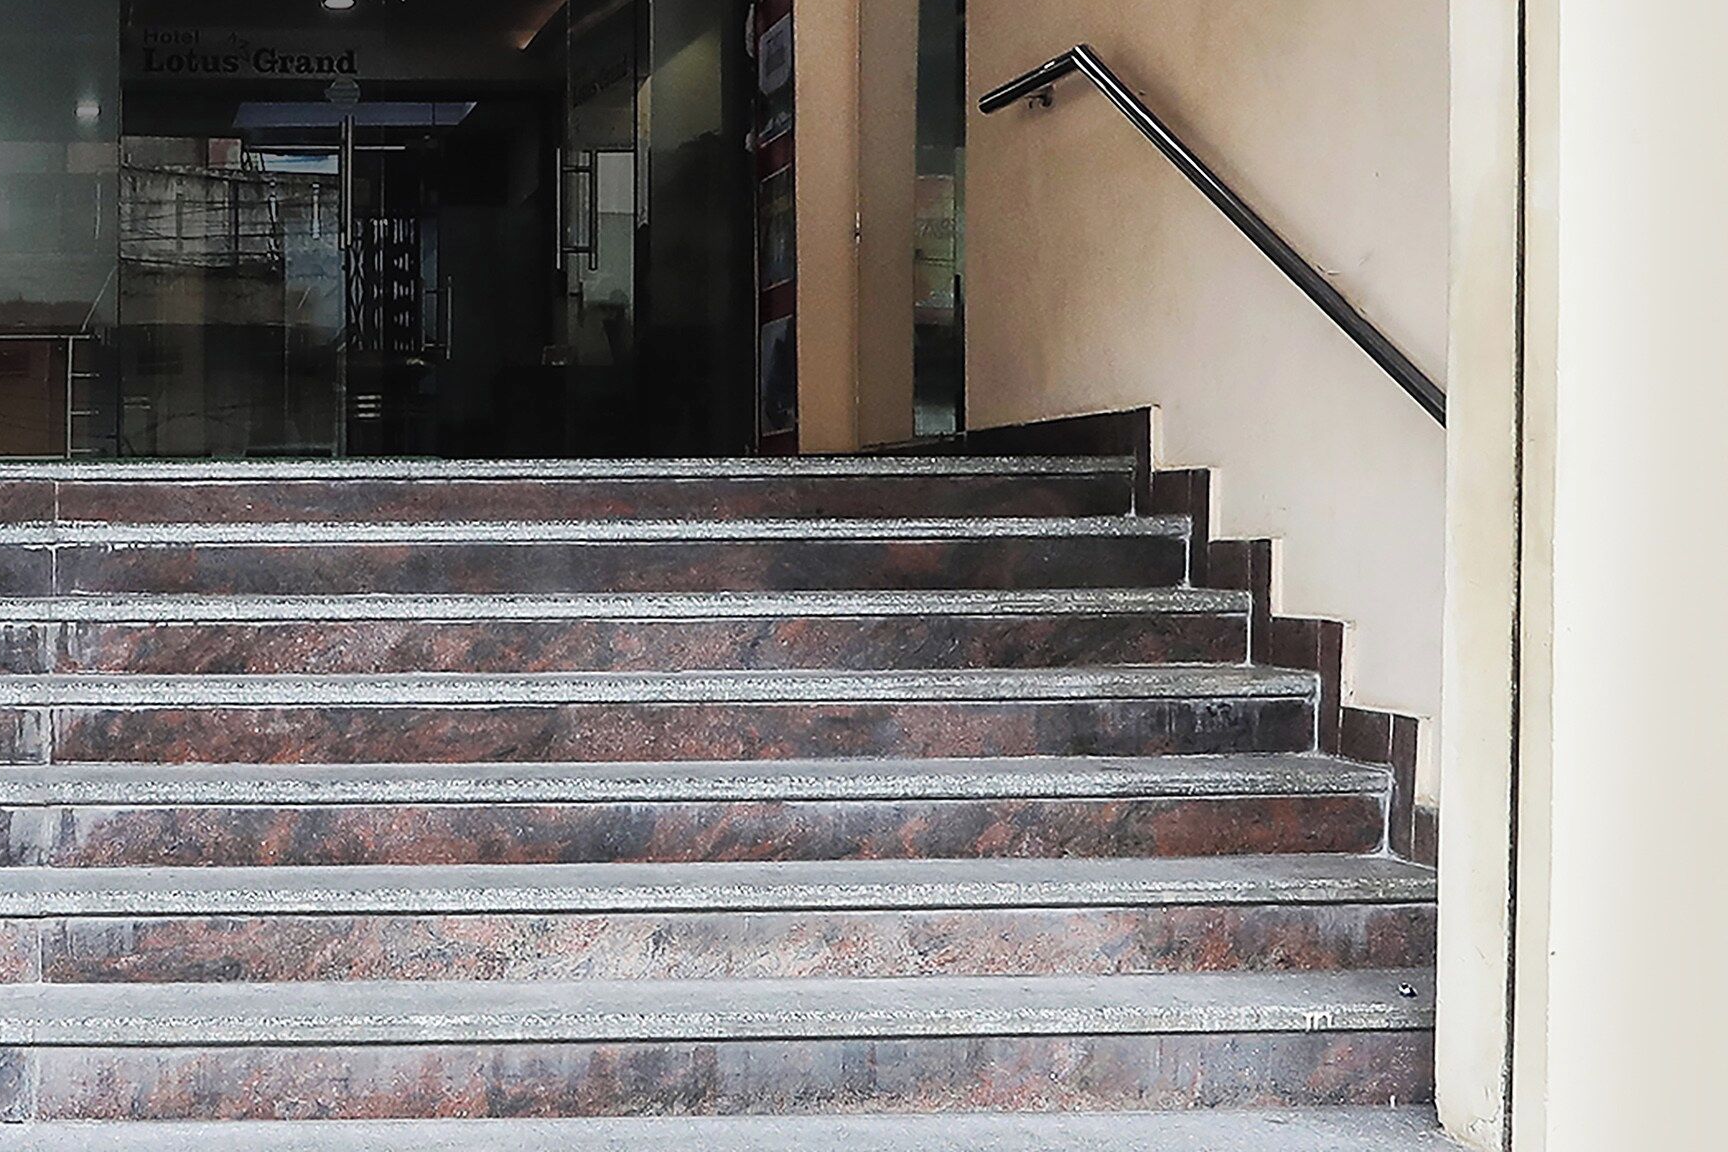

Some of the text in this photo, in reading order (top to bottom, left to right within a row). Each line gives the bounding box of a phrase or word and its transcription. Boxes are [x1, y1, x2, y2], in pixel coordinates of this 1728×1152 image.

[143, 28, 199, 45] Hotel
[143, 47, 357, 75] Lotus Grand
